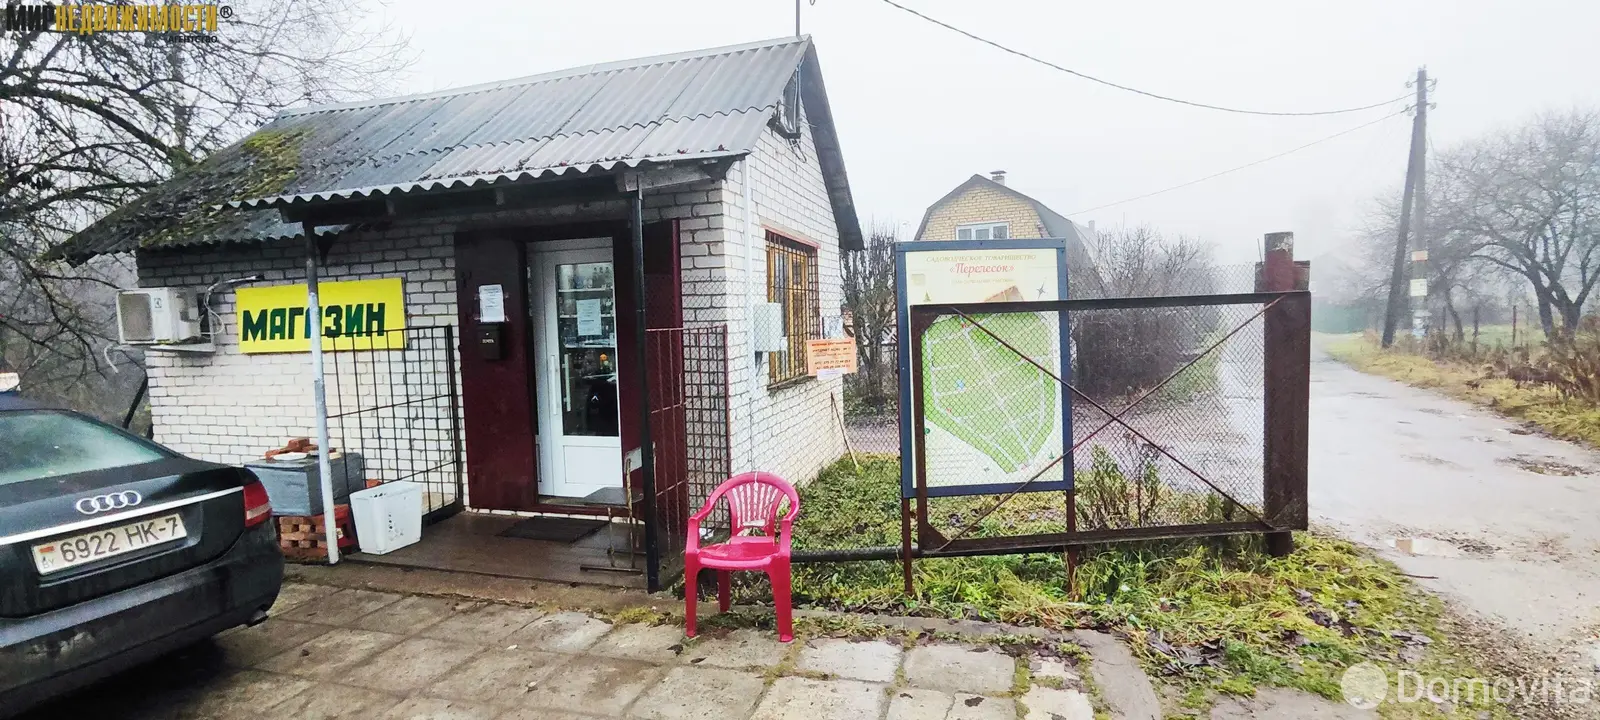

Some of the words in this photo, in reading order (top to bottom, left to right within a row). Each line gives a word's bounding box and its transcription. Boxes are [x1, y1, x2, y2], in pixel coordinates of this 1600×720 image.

[926, 255, 982, 263] САДОВОДЧЕСКОЕ
[60, 531, 120, 563] 6922
[124, 516, 178, 547] HK-7
